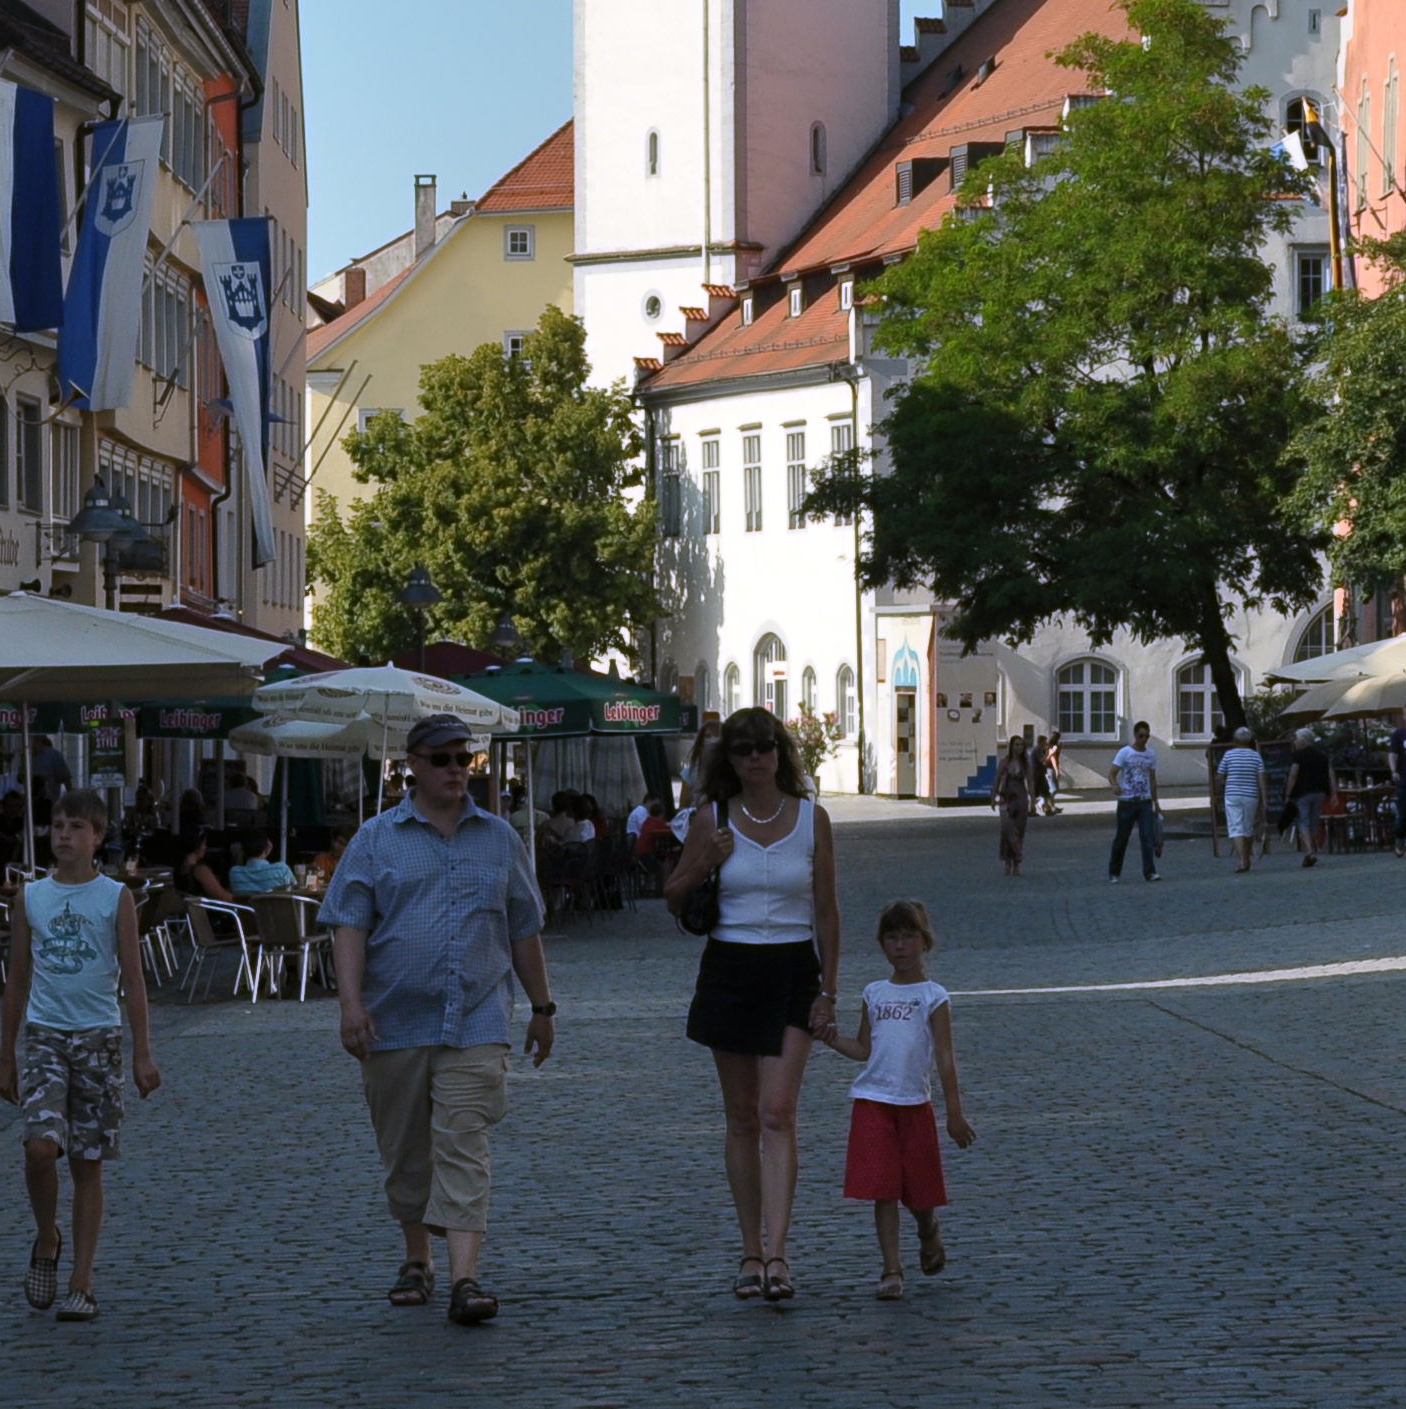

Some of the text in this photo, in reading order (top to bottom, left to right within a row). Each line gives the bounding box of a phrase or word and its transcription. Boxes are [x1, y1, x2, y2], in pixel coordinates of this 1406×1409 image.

[159, 708, 222, 733] Leibinger
[517, 706, 566, 730] inger
[603, 700, 661, 726] Leibinger
[876, 1005, 913, 1021] 1862
